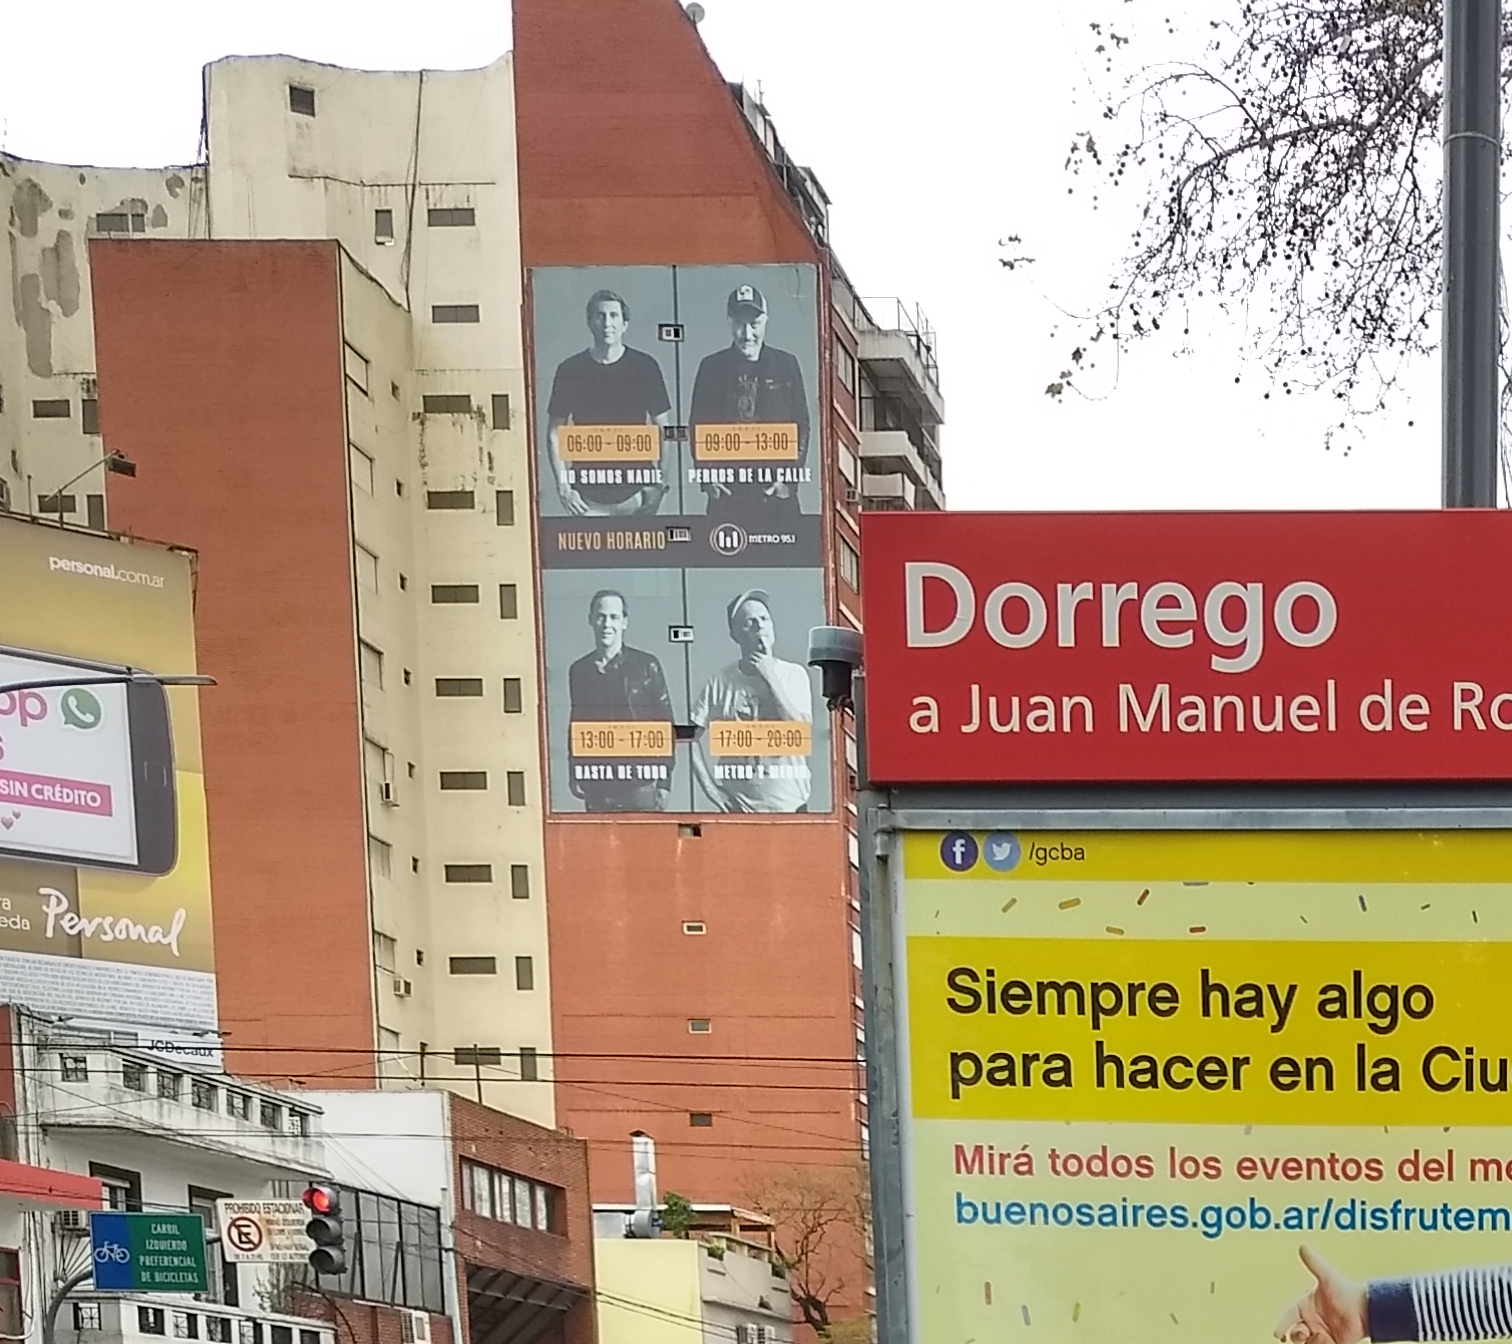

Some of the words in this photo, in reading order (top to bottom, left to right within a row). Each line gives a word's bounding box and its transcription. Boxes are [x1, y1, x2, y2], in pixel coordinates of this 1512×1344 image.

[567, 435, 602, 452] 06:00
[617, 435, 651, 452] 09:00
[705, 433, 740, 451] 09:00
[755, 433, 788, 451] 13:00
[580, 469, 622, 484] SOMOS
[627, 469, 662, 484] NADIE
[688, 468, 734, 483] PERROS
[739, 468, 753, 483] DE
[758, 467, 772, 482] LA
[776, 467, 811, 483] CALLE
[558, 532, 601, 551] NUEVO
[606, 531, 666, 550] HORARIO
[49, 556, 165, 588] personal.com.ar
[905, 562, 1336, 673] Dorrego
[910, 697, 938, 732] a
[961, 685, 1093, 732] Juan
[1120, 680, 1335, 732] Manuel
[1360, 679, 1429, 731] de
[580, 730, 615, 749] 13:00
[629, 730, 665, 749] 17:00
[719, 730, 752, 748] 17:00
[767, 730, 802, 748] 20:00
[575, 765, 614, 779] BASTA
[617, 765, 633, 779] DE
[636, 765, 667, 779] TODO
[714, 764, 753, 779] METRO
[0, 779, 28, 798] SIN
[31, 783, 102, 808] CRÉDITO
[1029, 842, 1085, 867] /gcba
[39, 887, 186, 957] Personal
[947, 968, 1179, 1030] Siempre
[1201, 969, 1297, 1033] hay
[1318, 970, 1433, 1034] algo
[950, 1051, 1072, 1099] para
[1096, 1041, 1250, 1090] hacer
[1270, 1057, 1333, 1091] en
[1357, 1044, 1400, 1091] la
[955, 1145, 1033, 1175] Mirá
[1048, 1146, 1153, 1178] todos
[1170, 1147, 1221, 1179] los
[1237, 1153, 1383, 1181] eventos
[1398, 1149, 1453, 1181] del
[151, 1223, 180, 1235] CARRIL
[139, 1255, 196, 1268] PREFERENCIAL
[141, 1272, 152, 1283] DE
[154, 1273, 199, 1284] BICICLETAS
